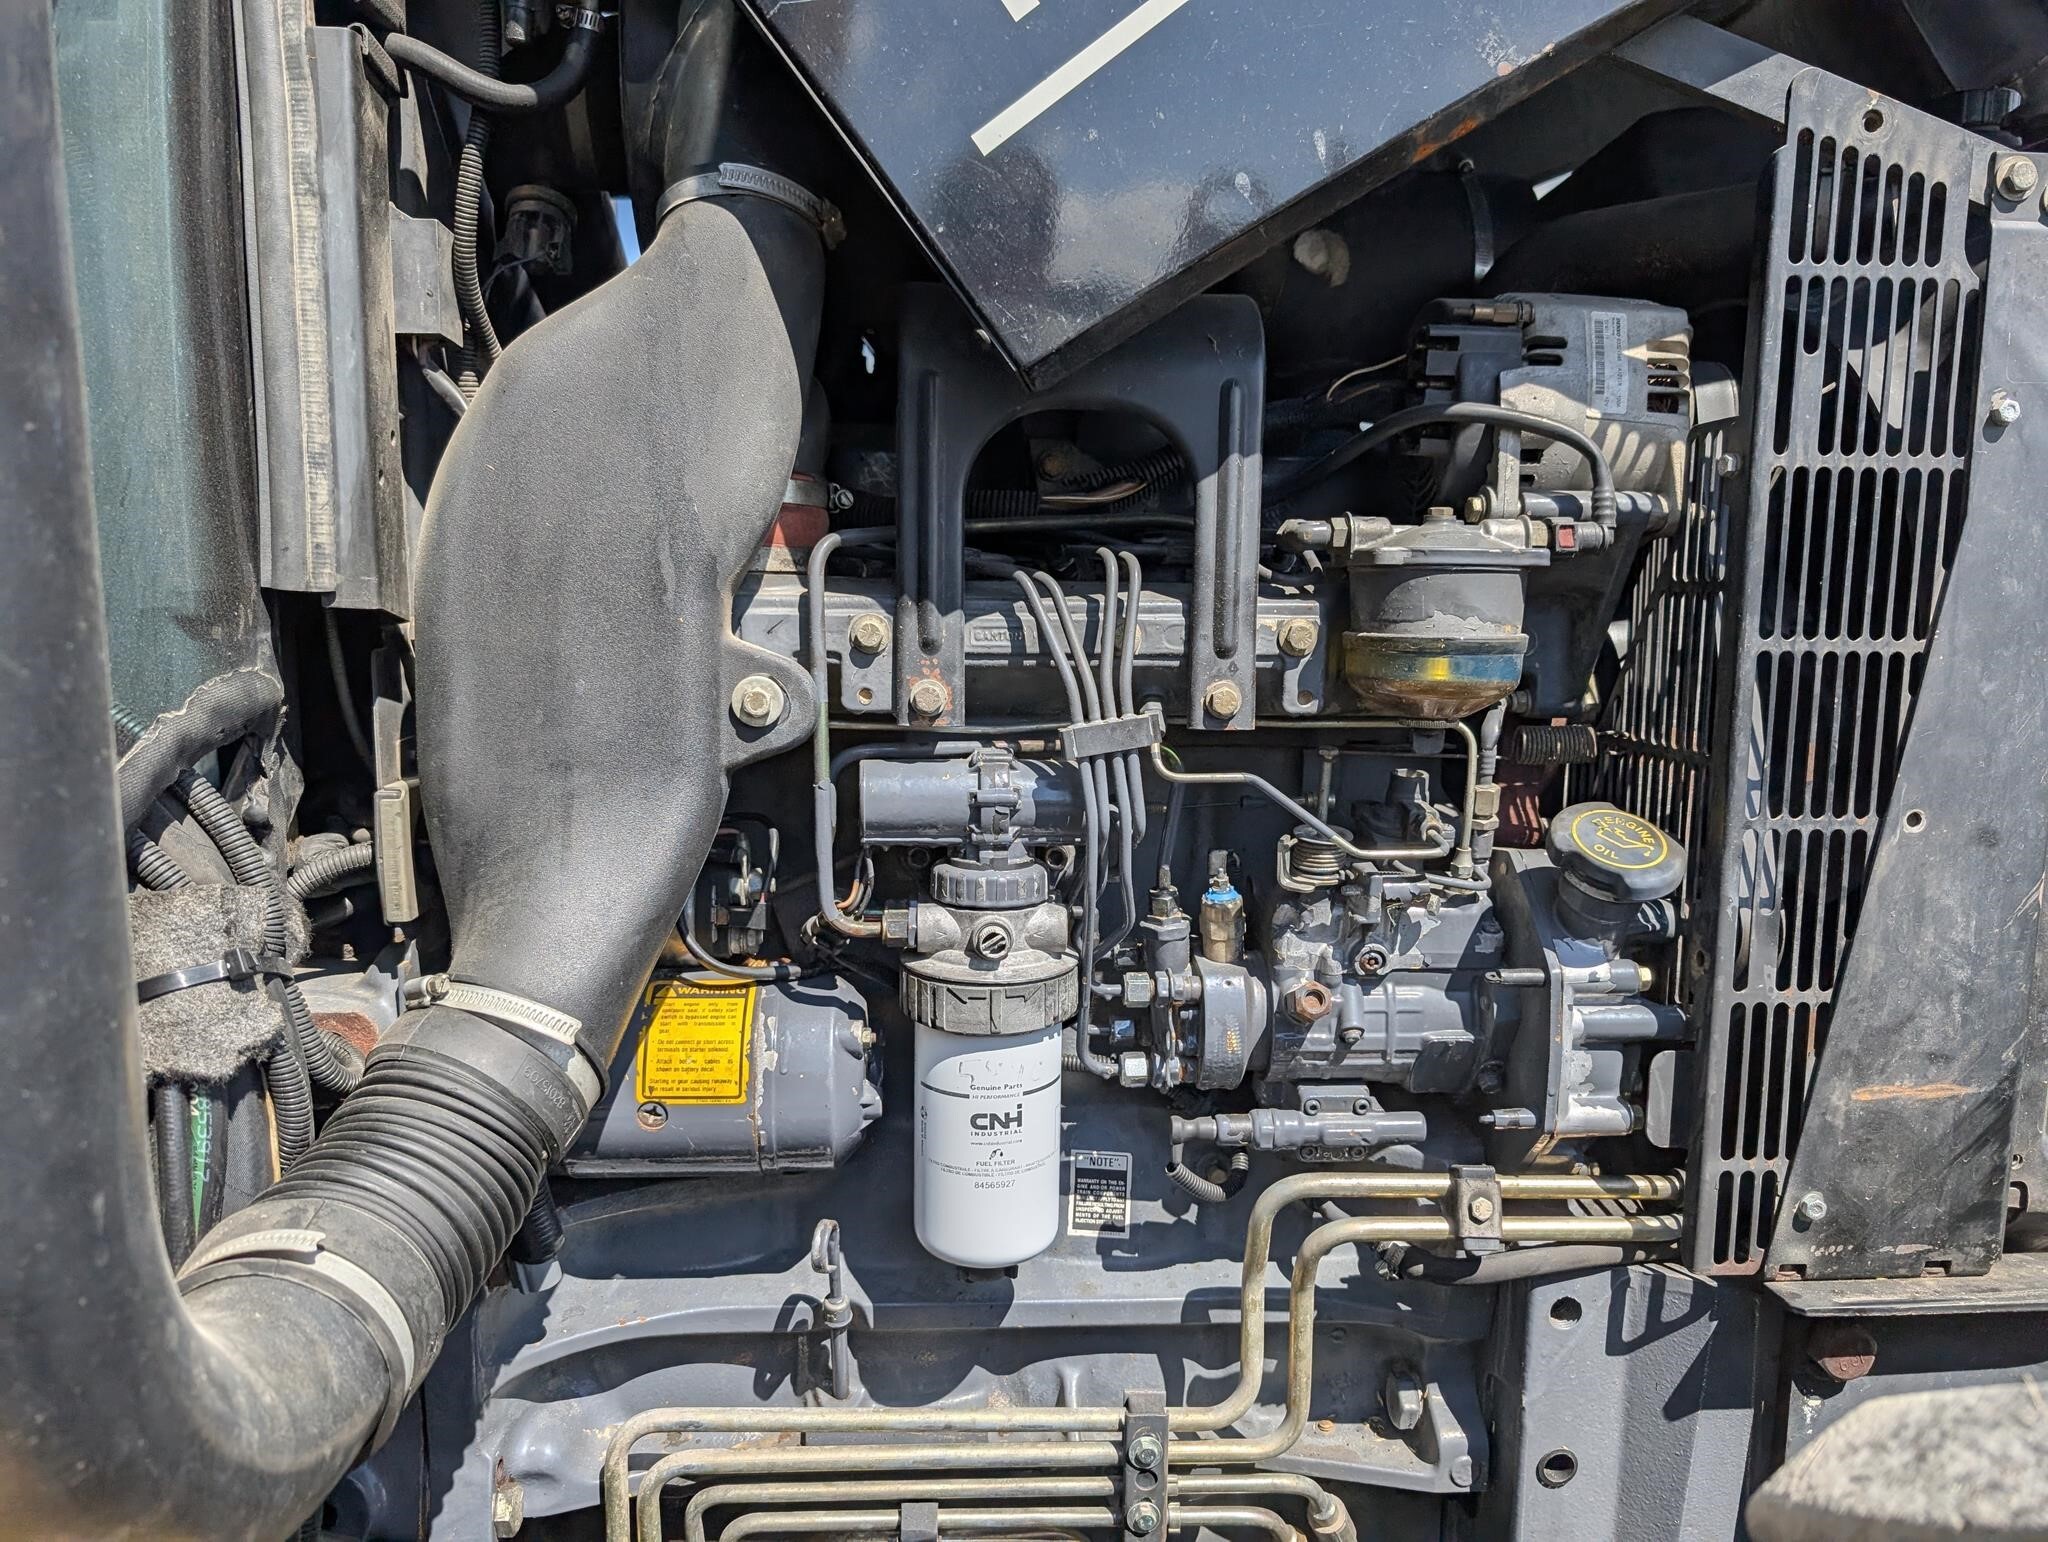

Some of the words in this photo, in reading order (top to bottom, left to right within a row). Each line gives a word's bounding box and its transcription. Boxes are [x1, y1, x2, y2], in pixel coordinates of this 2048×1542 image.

[1604, 816, 1655, 846] ENGINE
[1593, 843, 1619, 860] OIL
[678, 987, 746, 995] WARNING
[1004, 1082, 1022, 1090] Parts
[970, 1129, 1023, 1137] INDUSTRIAL
[974, 1180, 1016, 1189] 84565927
